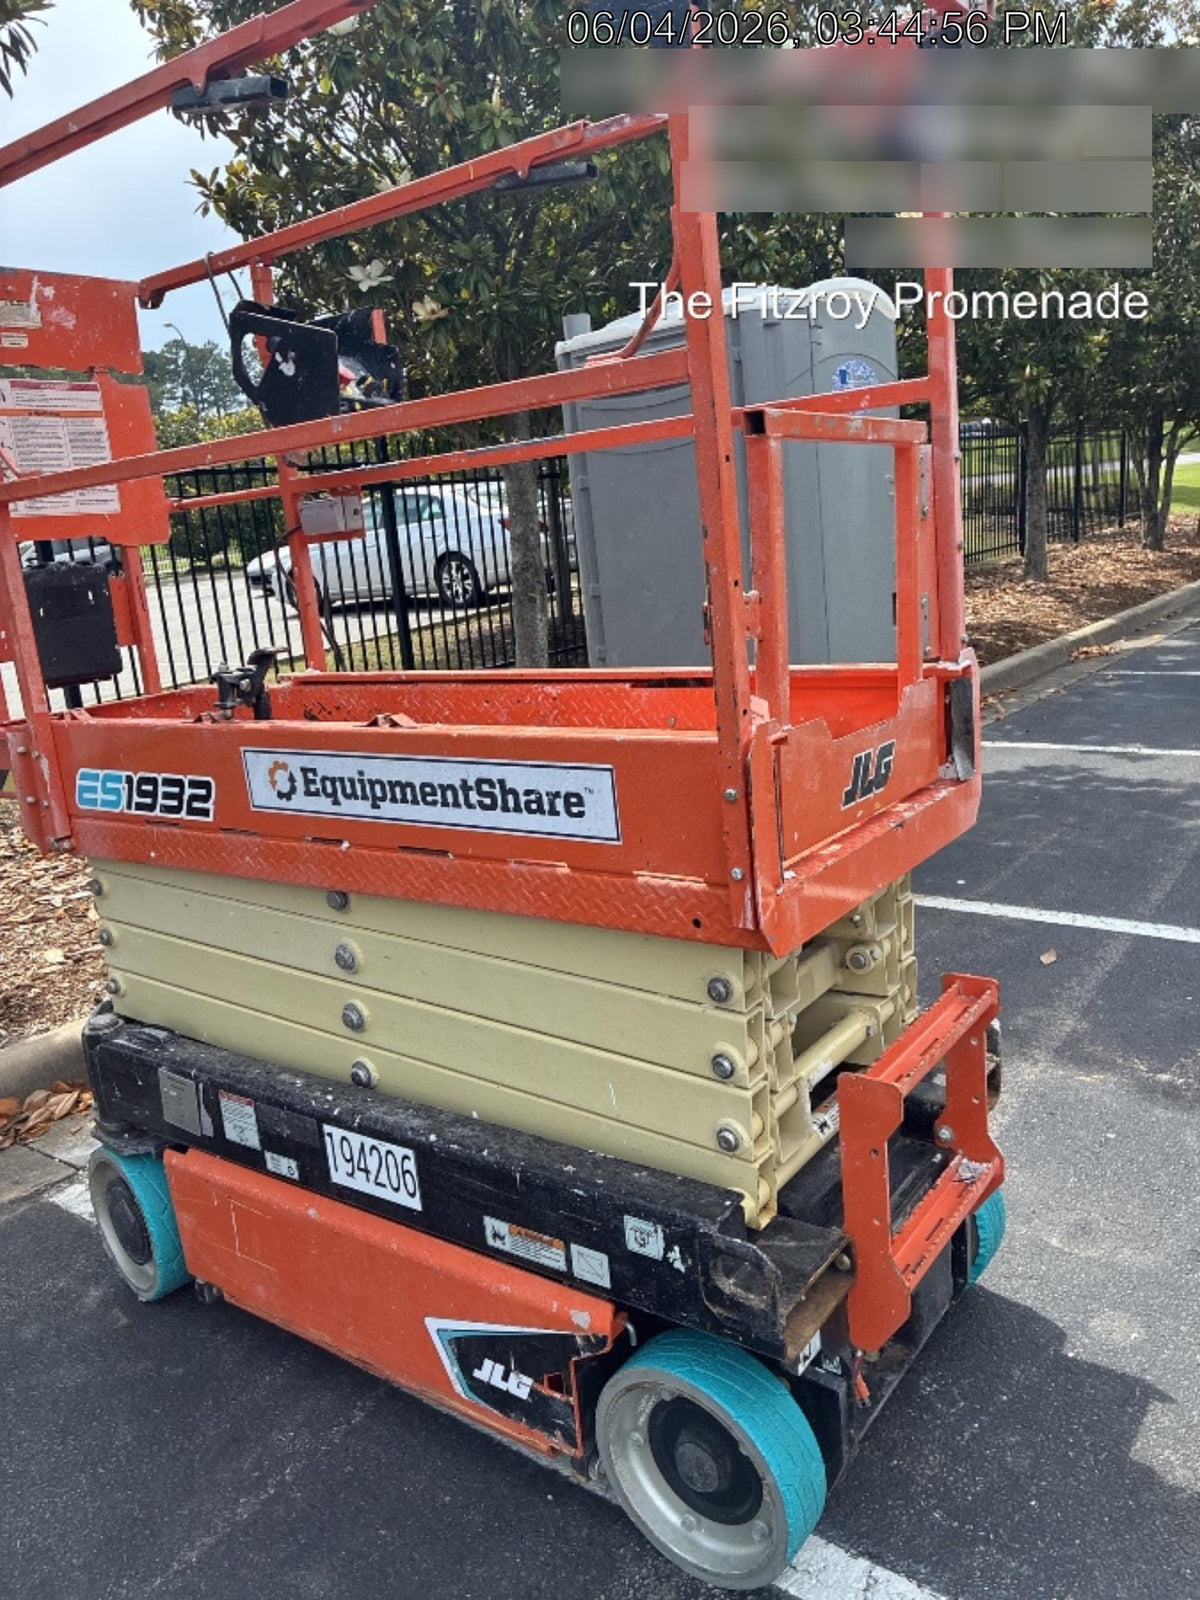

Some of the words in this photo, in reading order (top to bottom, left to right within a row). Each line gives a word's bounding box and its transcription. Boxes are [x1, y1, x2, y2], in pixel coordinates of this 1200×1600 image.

[76, 768, 215, 821] ES1932
[841, 739, 896, 810] JLG
[325, 1131, 420, 1199] 194206
[472, 1357, 534, 1401] JLG
